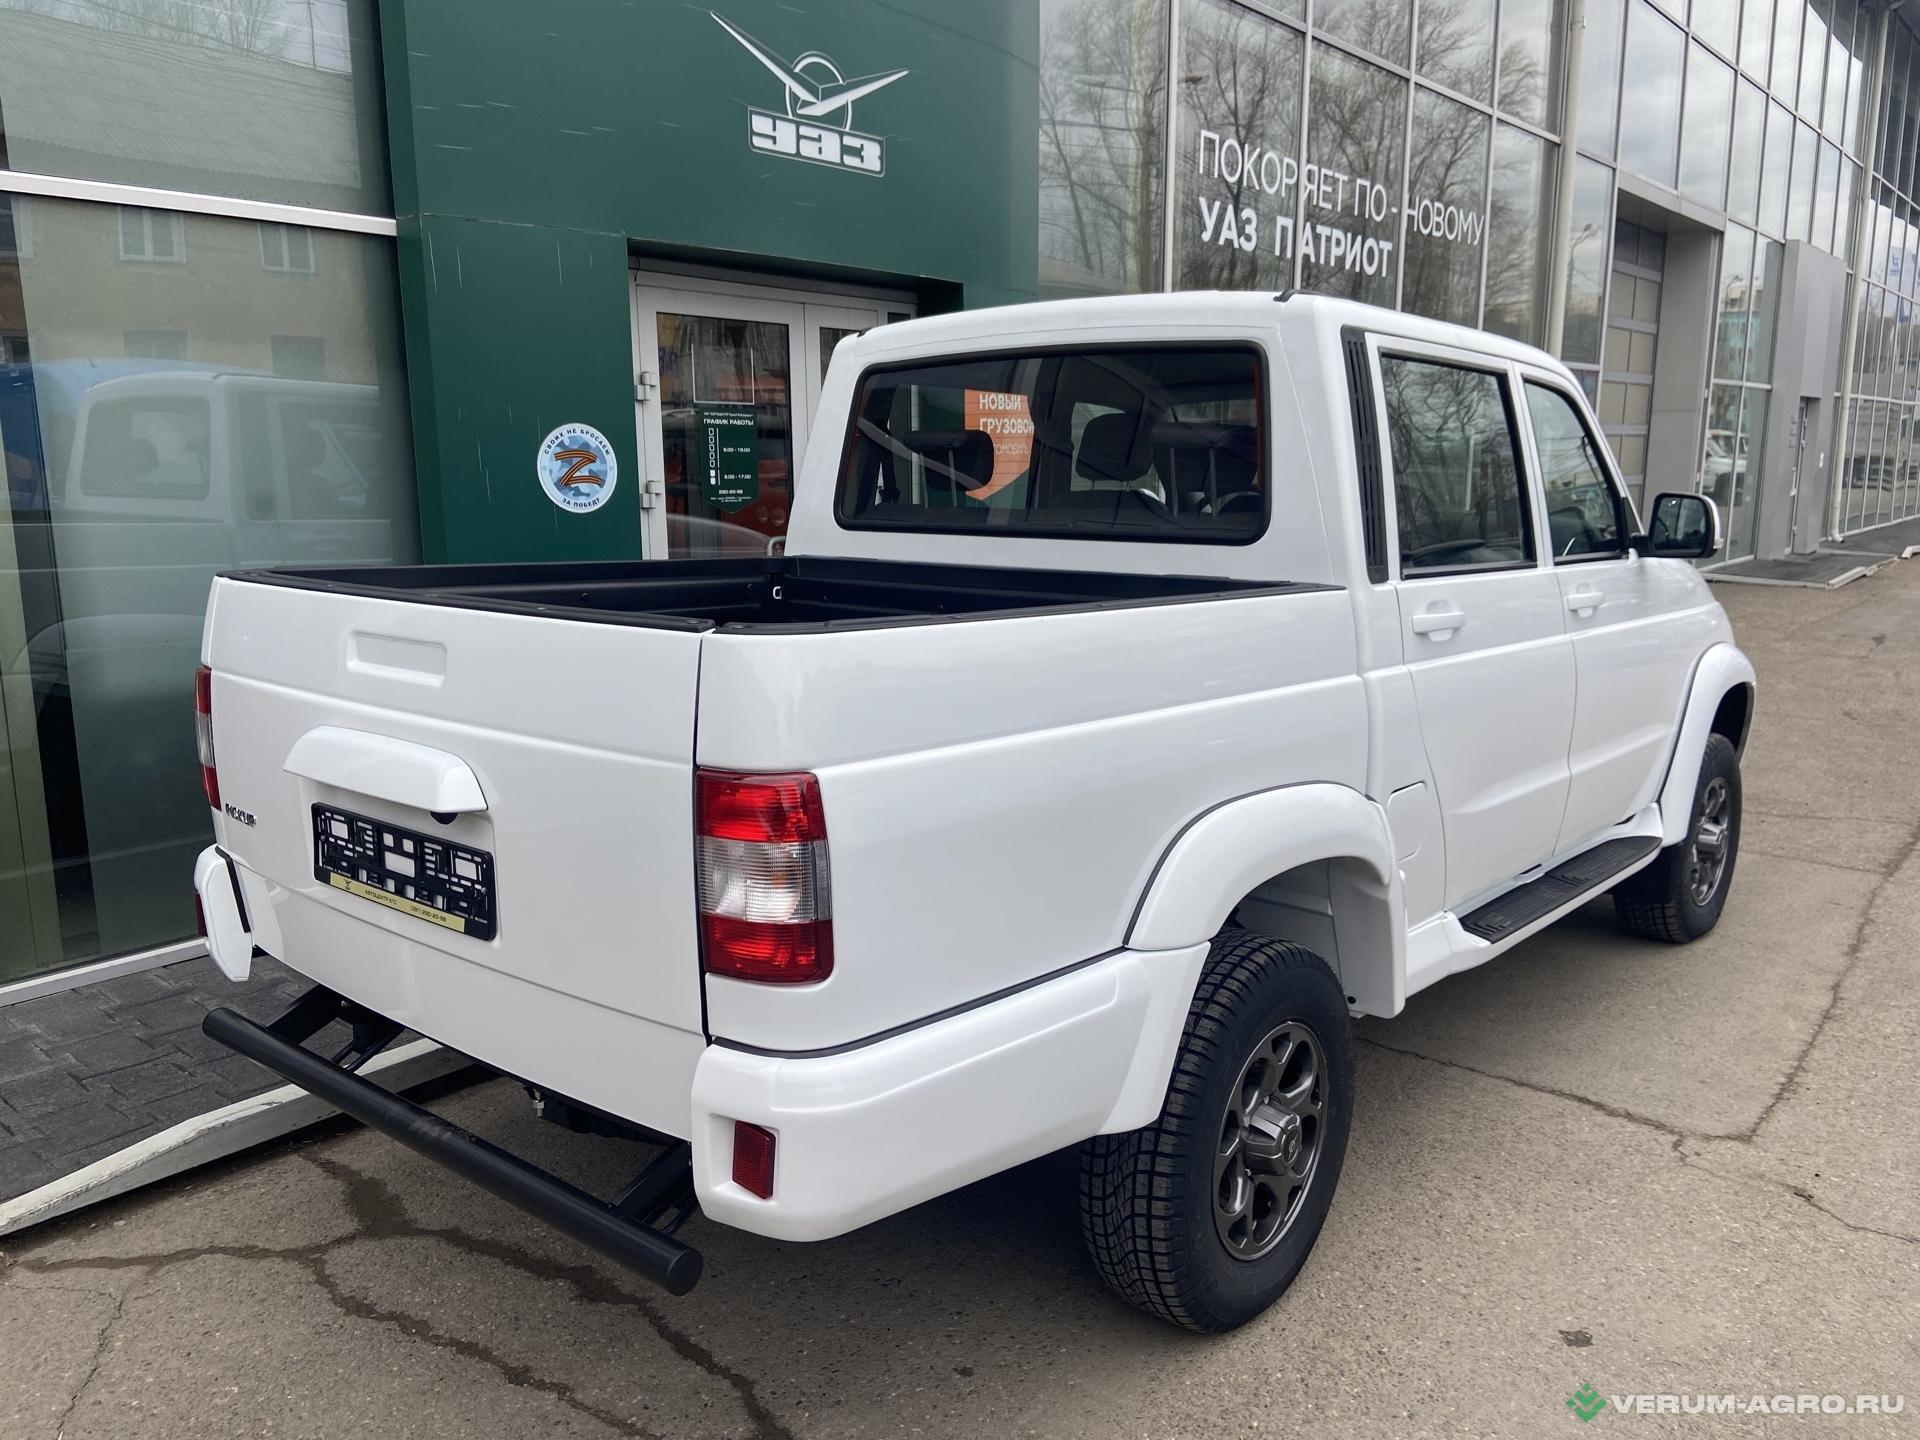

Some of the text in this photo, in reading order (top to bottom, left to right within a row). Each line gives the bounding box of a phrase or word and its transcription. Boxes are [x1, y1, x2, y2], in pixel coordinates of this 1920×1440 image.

[1199, 129, 1348, 212] ПОКОРЯЕТ
[1199, 196, 1393, 278] УАЗ ПАТРИОТ
[544, 432, 564, 455] СВОИХ
[580, 428, 611, 456] БРОСАЕМ
[562, 497, 600, 508] ЗА ПОБЕДУ
